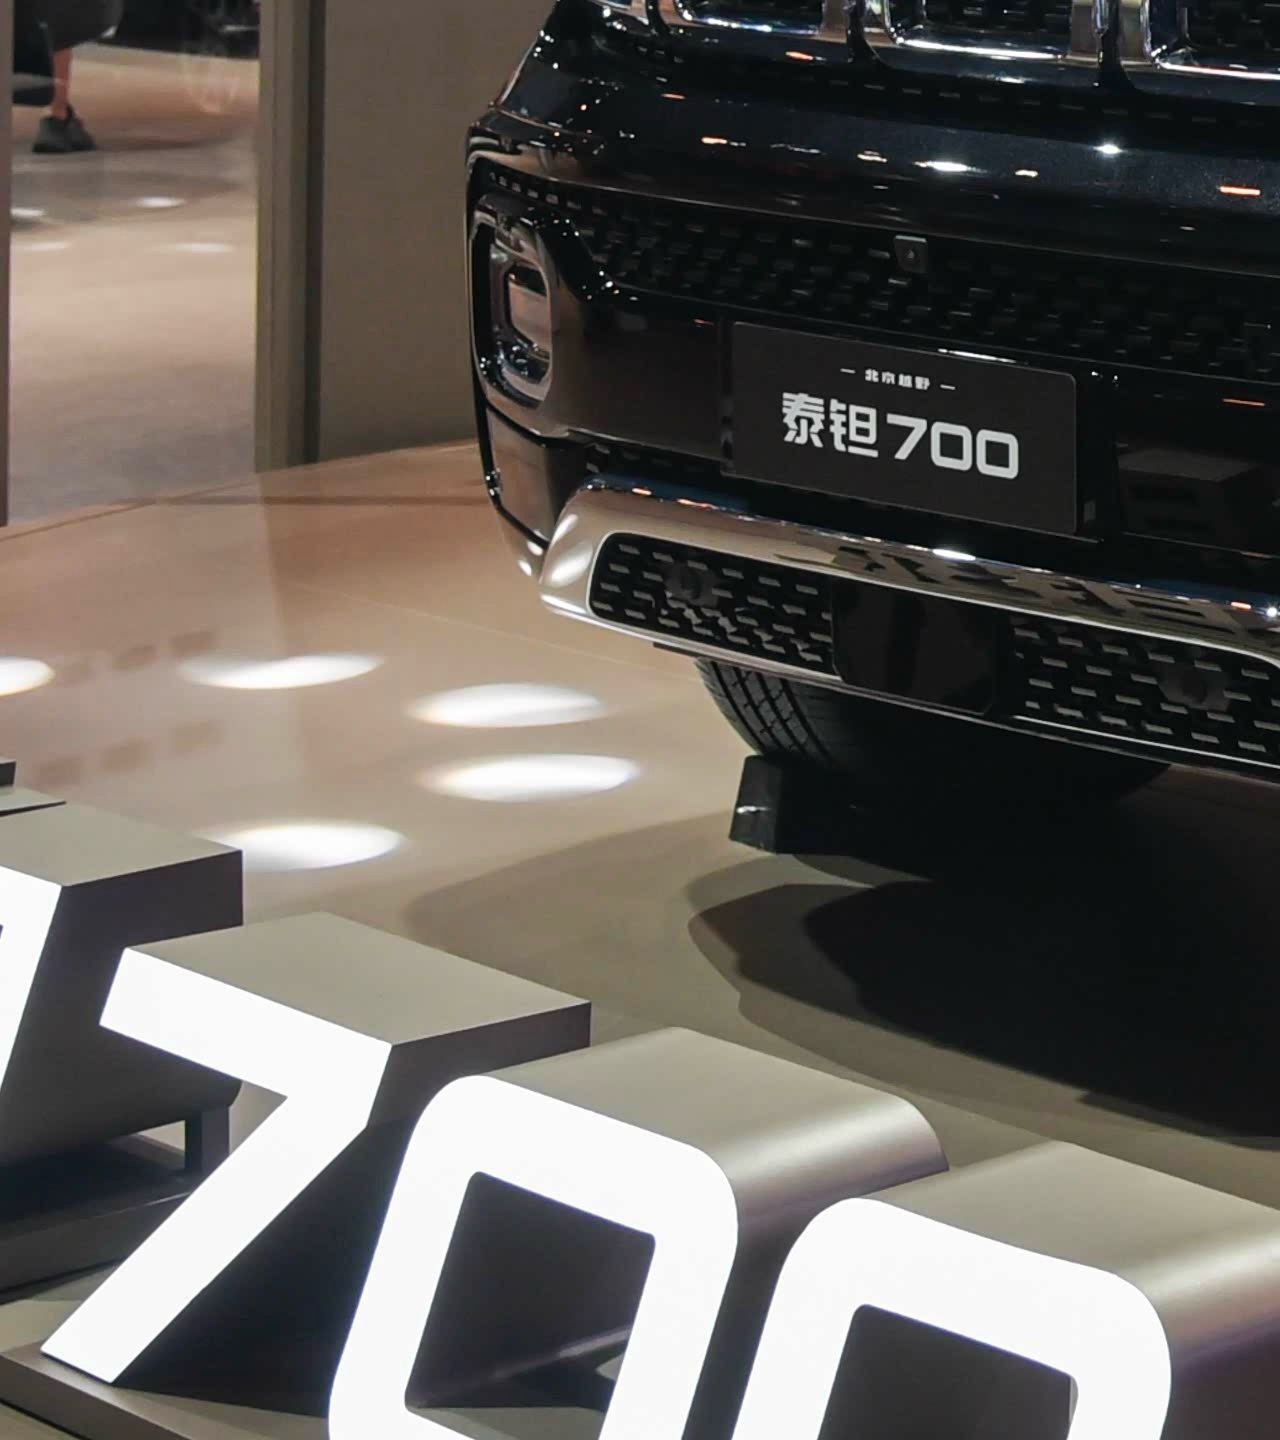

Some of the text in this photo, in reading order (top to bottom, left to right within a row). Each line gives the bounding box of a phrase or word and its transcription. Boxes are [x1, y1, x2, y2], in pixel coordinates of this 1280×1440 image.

[864, 368, 931, 391] 北京越野
[781, 392, 1020, 481] 泰钽 700
